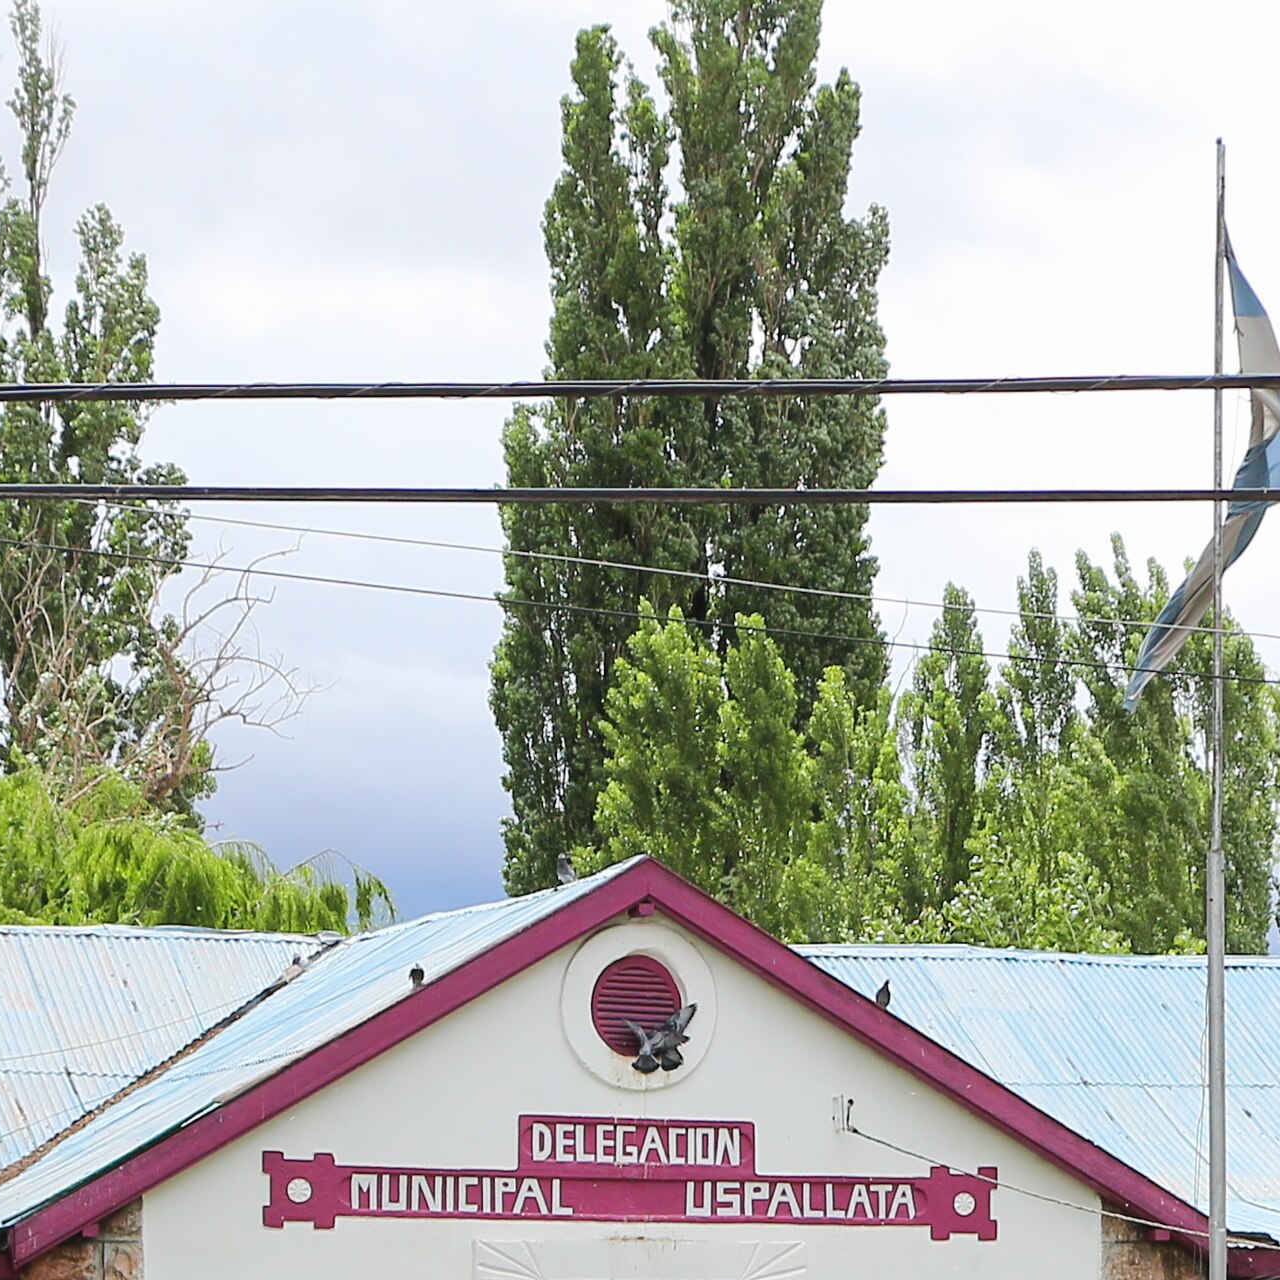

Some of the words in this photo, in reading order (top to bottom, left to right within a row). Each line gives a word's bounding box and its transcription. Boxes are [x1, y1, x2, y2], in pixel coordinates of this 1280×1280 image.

[533, 1123, 740, 1166] DELEGACION
[350, 1173, 574, 1215] MUNICIPAL
[685, 1181, 917, 1219] USPALLATA
